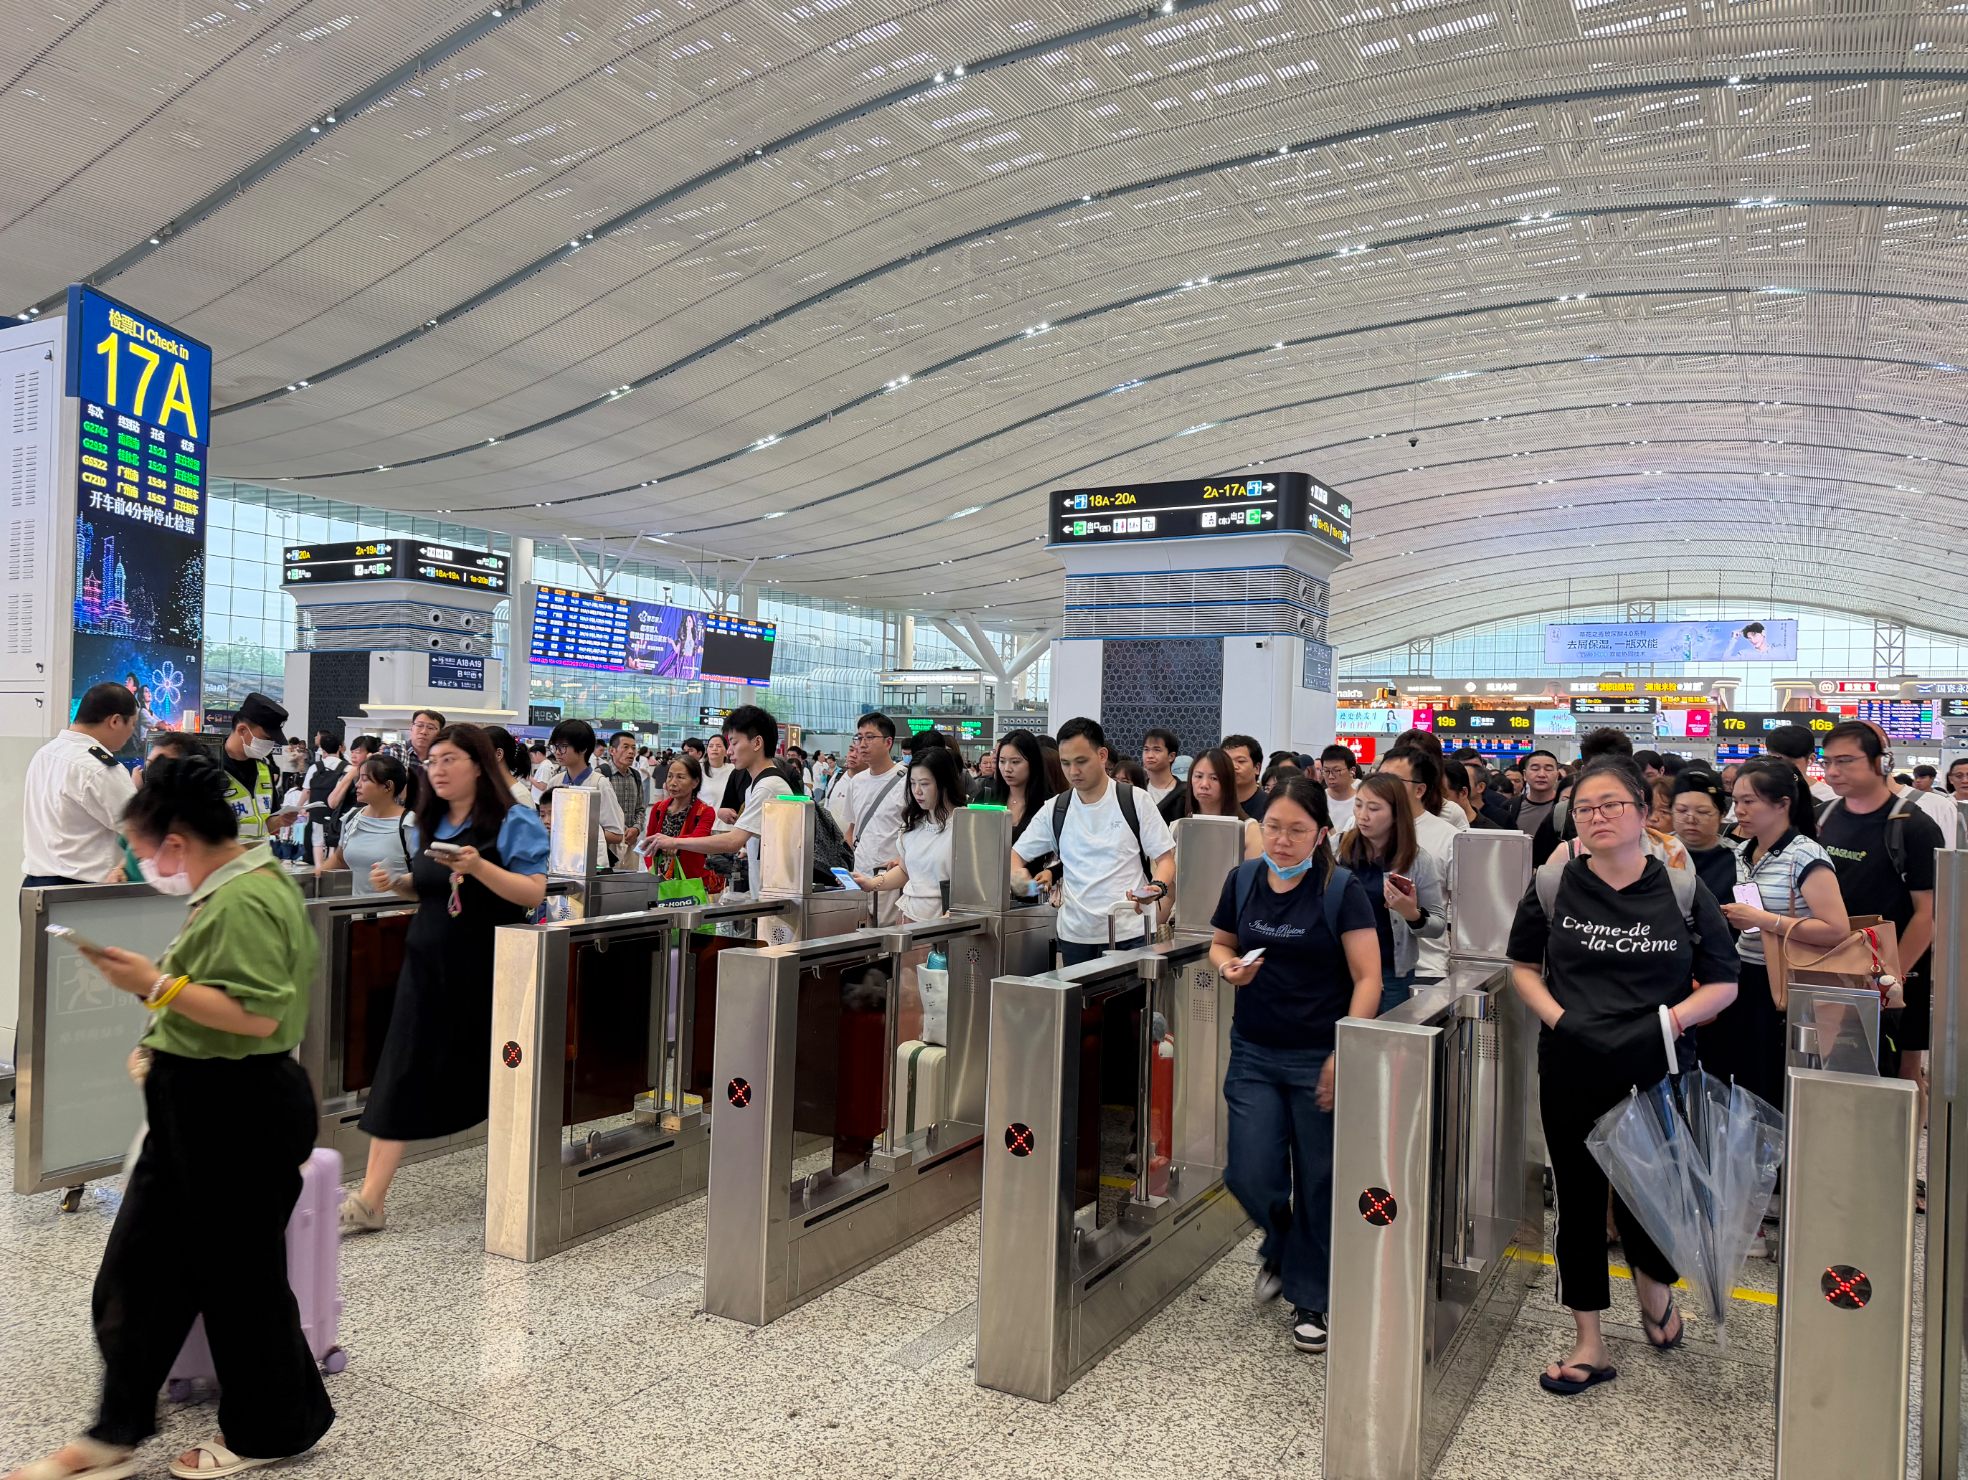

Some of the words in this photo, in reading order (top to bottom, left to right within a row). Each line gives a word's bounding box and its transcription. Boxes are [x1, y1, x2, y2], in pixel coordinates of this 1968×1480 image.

[109, 308, 144, 341] 检票口
[147, 329, 178, 356] Check
[180, 344, 189, 360] in
[97, 332, 198, 439] 17A
[87, 403, 104, 420] 车次
[150, 427, 165, 443] 开点
[181, 438, 195, 453] 状态
[83, 421, 109, 438] G2742
[148, 444, 168, 459] 15:21
[117, 465, 139, 483] 广州南
[82, 472, 107, 487] C7210
[116, 482, 139, 499] 广州南
[147, 492, 167, 506] 15:52
[1203, 483, 1247, 499] 2A-17A
[1089, 492, 1137, 507] 18A-20A
[89, 490, 196, 535] 开车前4分钟停止检票
[298, 551, 311, 561] 20A
[435, 569, 460, 580] 18A-19A
[457, 669, 463, 678] B
[1337, 689, 1364, 698] nald's
[1935, 684, 1968, 694] 国瓷永
[1436, 716, 1457, 727] 19B
[1509, 716, 1530, 728] 18B
[1722, 718, 1746, 730] 17B
[1808, 718, 1835, 731] 16B
[1248, 919, 1275, 934] Italian
[1275, 923, 1306, 936] Riviera
[1562, 915, 1651, 937] Crème-de
[1580, 935, 1678, 953] -la-Crème
